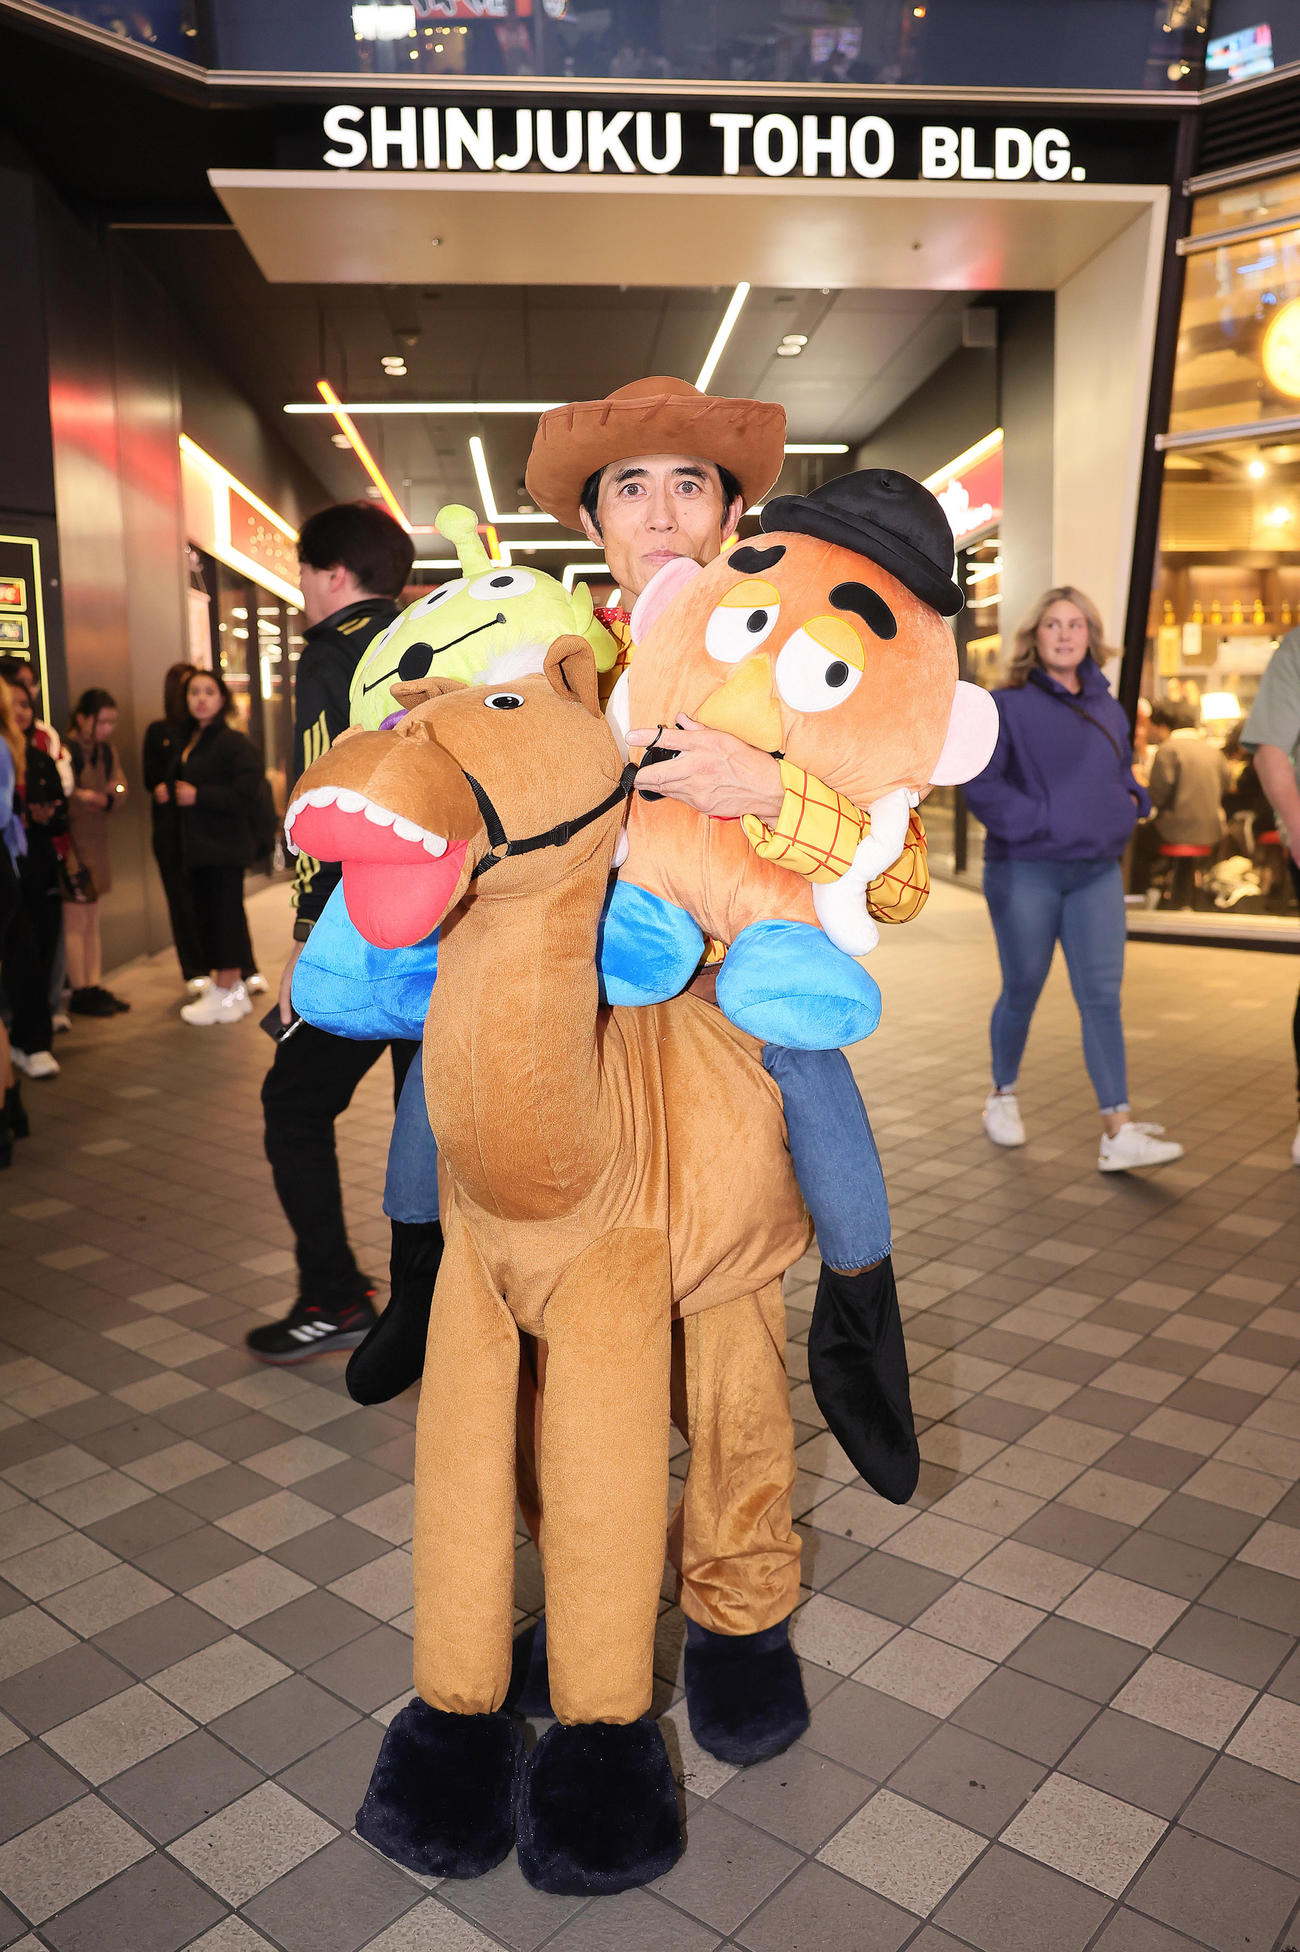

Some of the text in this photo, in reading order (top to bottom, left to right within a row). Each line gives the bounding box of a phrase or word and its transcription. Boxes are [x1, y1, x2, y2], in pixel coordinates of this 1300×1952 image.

[323, 105, 1086, 181] SHINJUKU TOHO BLDG.
